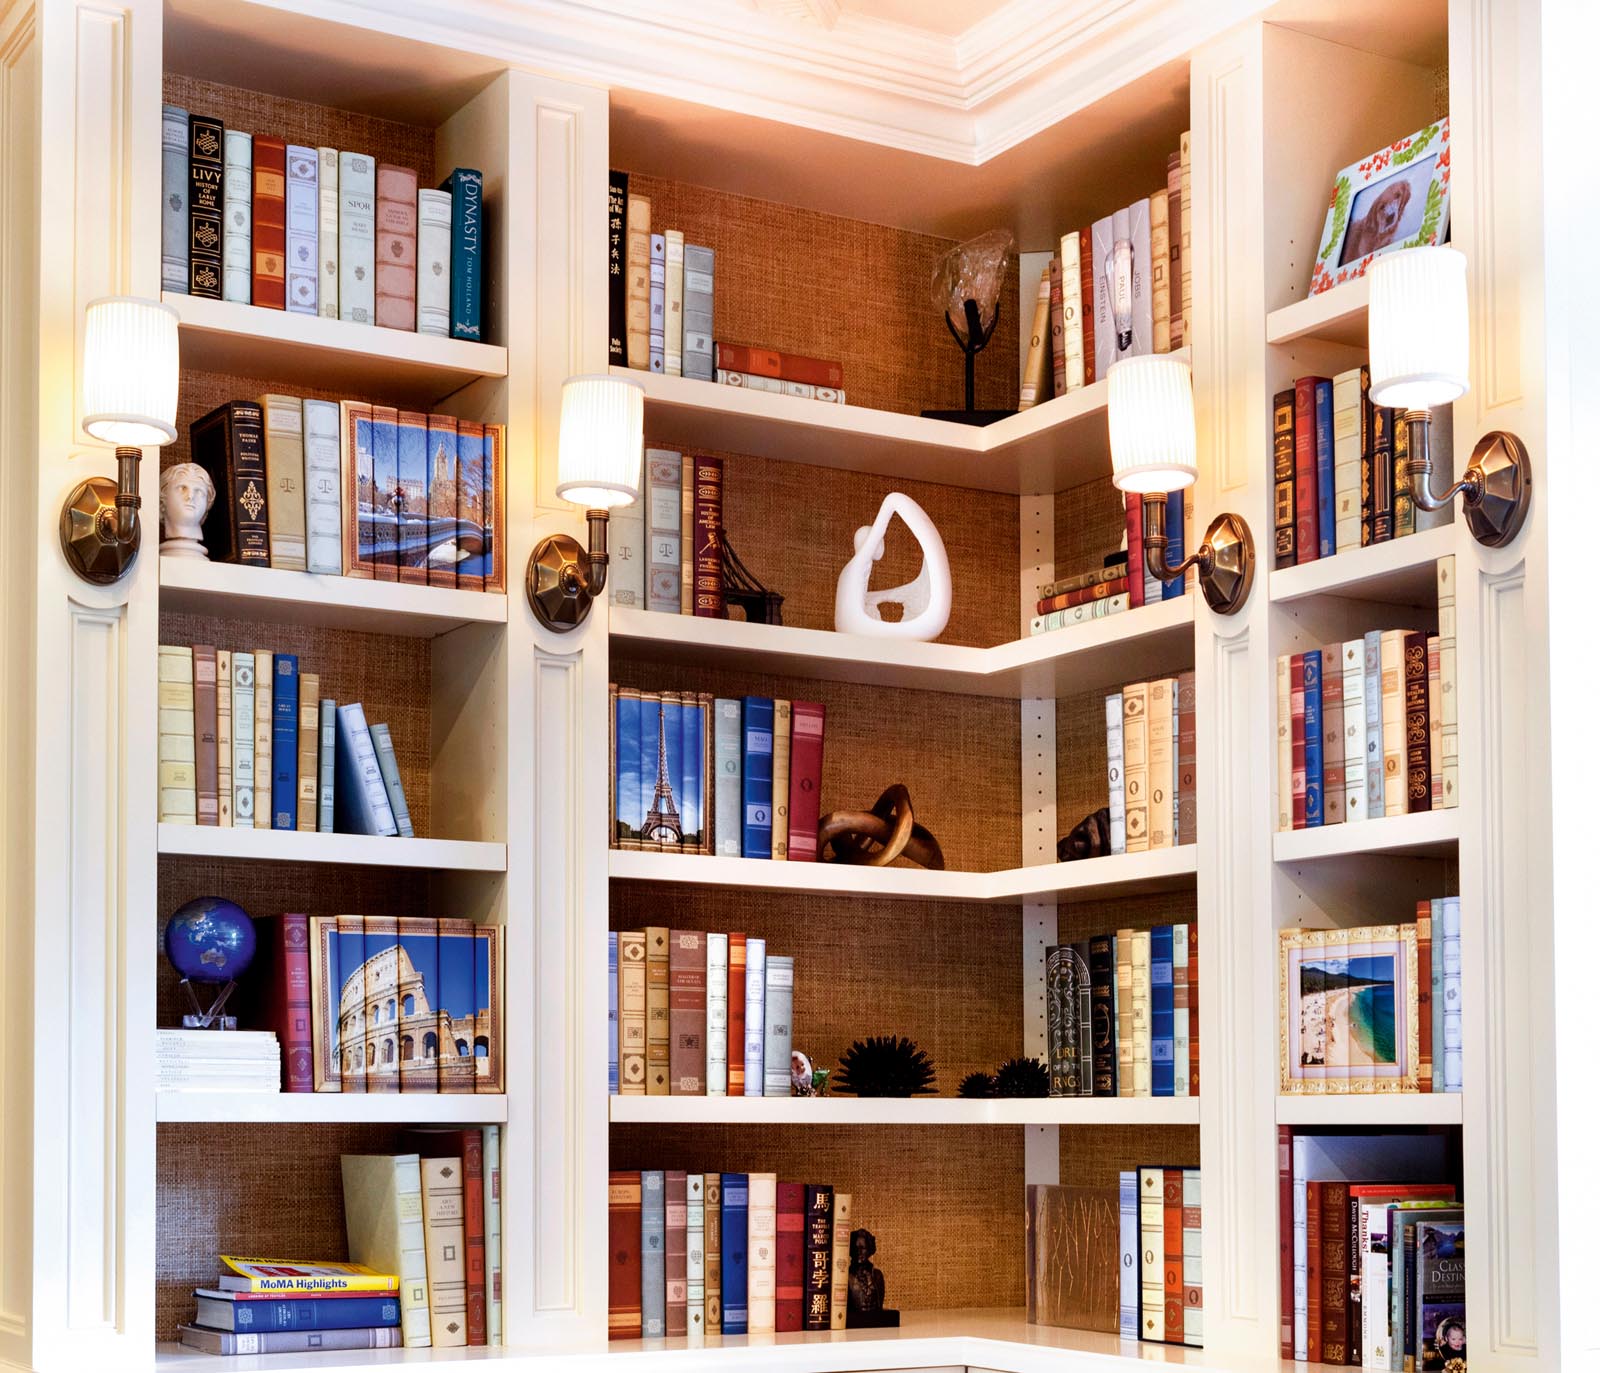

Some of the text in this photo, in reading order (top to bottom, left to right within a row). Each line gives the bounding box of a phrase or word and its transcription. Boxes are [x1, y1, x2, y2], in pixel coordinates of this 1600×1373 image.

[193, 168, 222, 183] LIVY
[195, 181, 218, 190] HISTORY
[199, 199, 215, 207] ROME
[347, 200, 371, 211] SPQR
[464, 183, 478, 254] DYNASTY
[1134, 270, 1142, 299] JOBS
[465, 276, 473, 314] HOLLAND
[1099, 275, 1107, 324] EINSTEIN
[813, 1192, 830, 1213] 馬
[1350, 1201, 1358, 1221] DAVID
[1361, 1210, 1369, 1253] Thanks!
[1439, 1259, 1465, 1272] CLAS
[260, 1279, 348, 1290] MoMA Highlights
